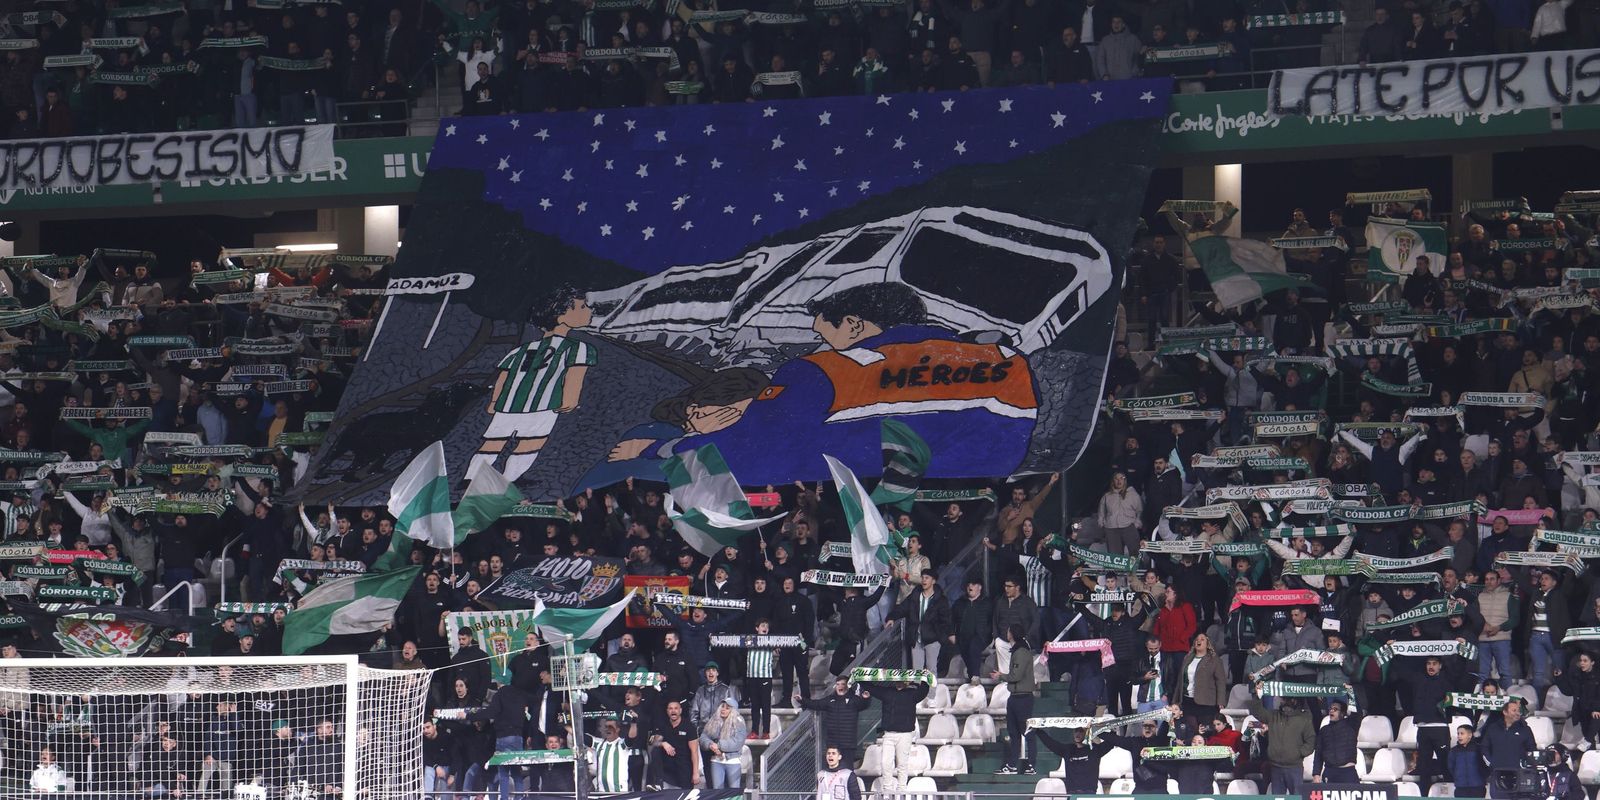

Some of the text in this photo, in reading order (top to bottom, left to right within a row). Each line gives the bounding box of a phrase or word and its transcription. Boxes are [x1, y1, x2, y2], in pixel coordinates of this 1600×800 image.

[1273, 66, 1410, 116] LATE
[1421, 56, 1529, 110] POR
[879, 355, 1013, 389] HÉROES
[1228, 486, 1253, 496] CÓRD
[1125, 592, 1136, 601] CF
[1430, 603, 1444, 614] CF
